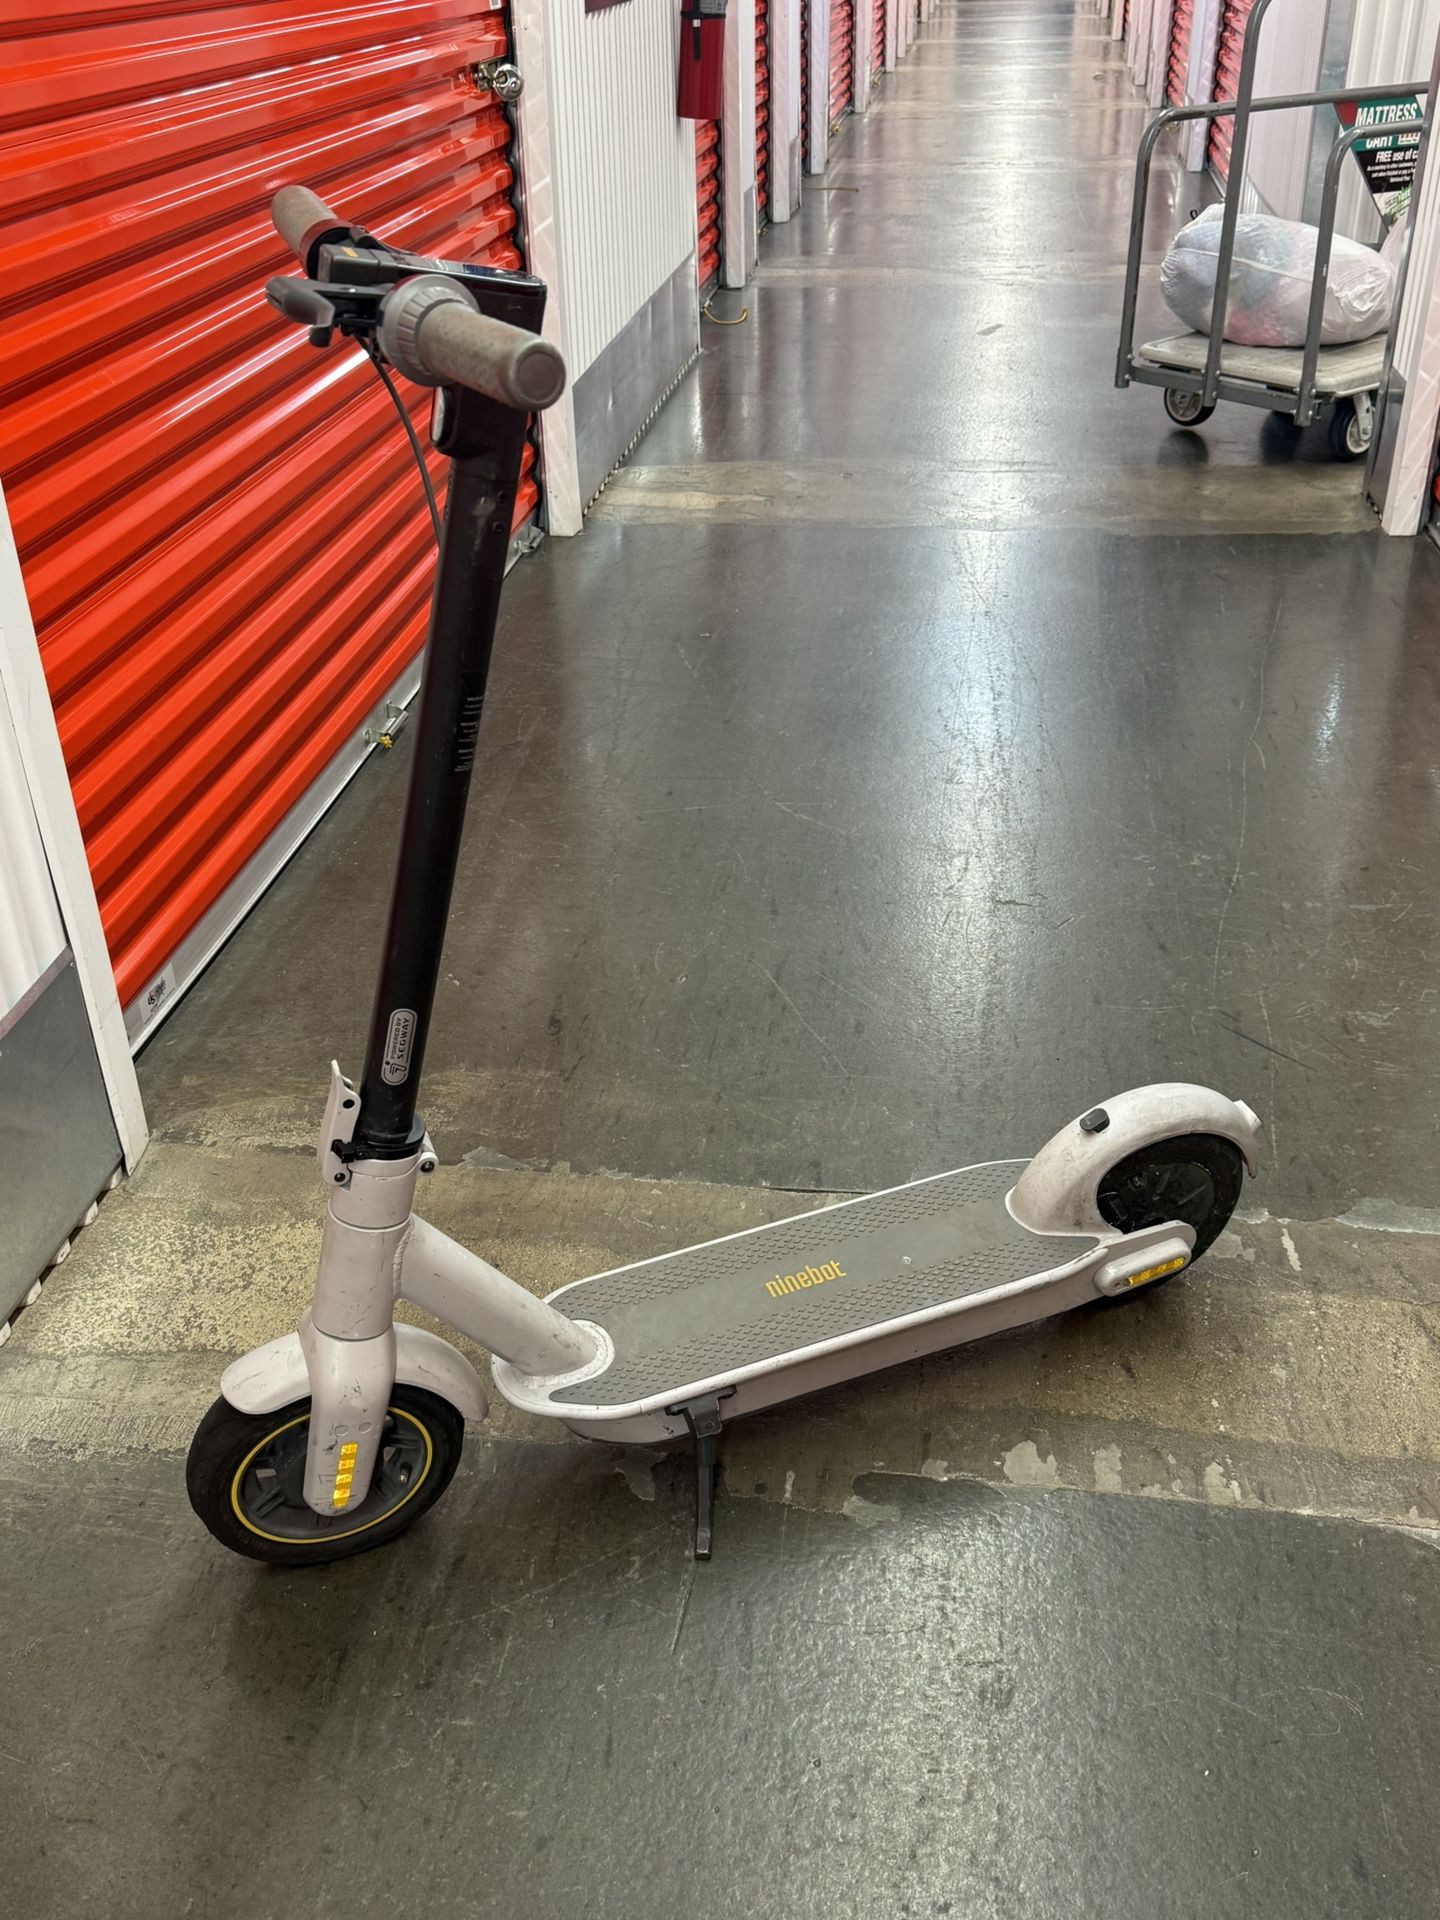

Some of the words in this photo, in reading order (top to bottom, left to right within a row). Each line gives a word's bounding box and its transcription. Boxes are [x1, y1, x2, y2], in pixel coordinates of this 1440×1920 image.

[1355, 103, 1418, 127] MATTRESS
[1375, 150, 1393, 162] FREE
[1392, 151, 1405, 161] use
[1405, 148, 1413, 160] of
[391, 1027, 401, 1059] POWERED
[397, 1018, 409, 1060] SEGWAY
[765, 1260, 848, 1298] ninebot
